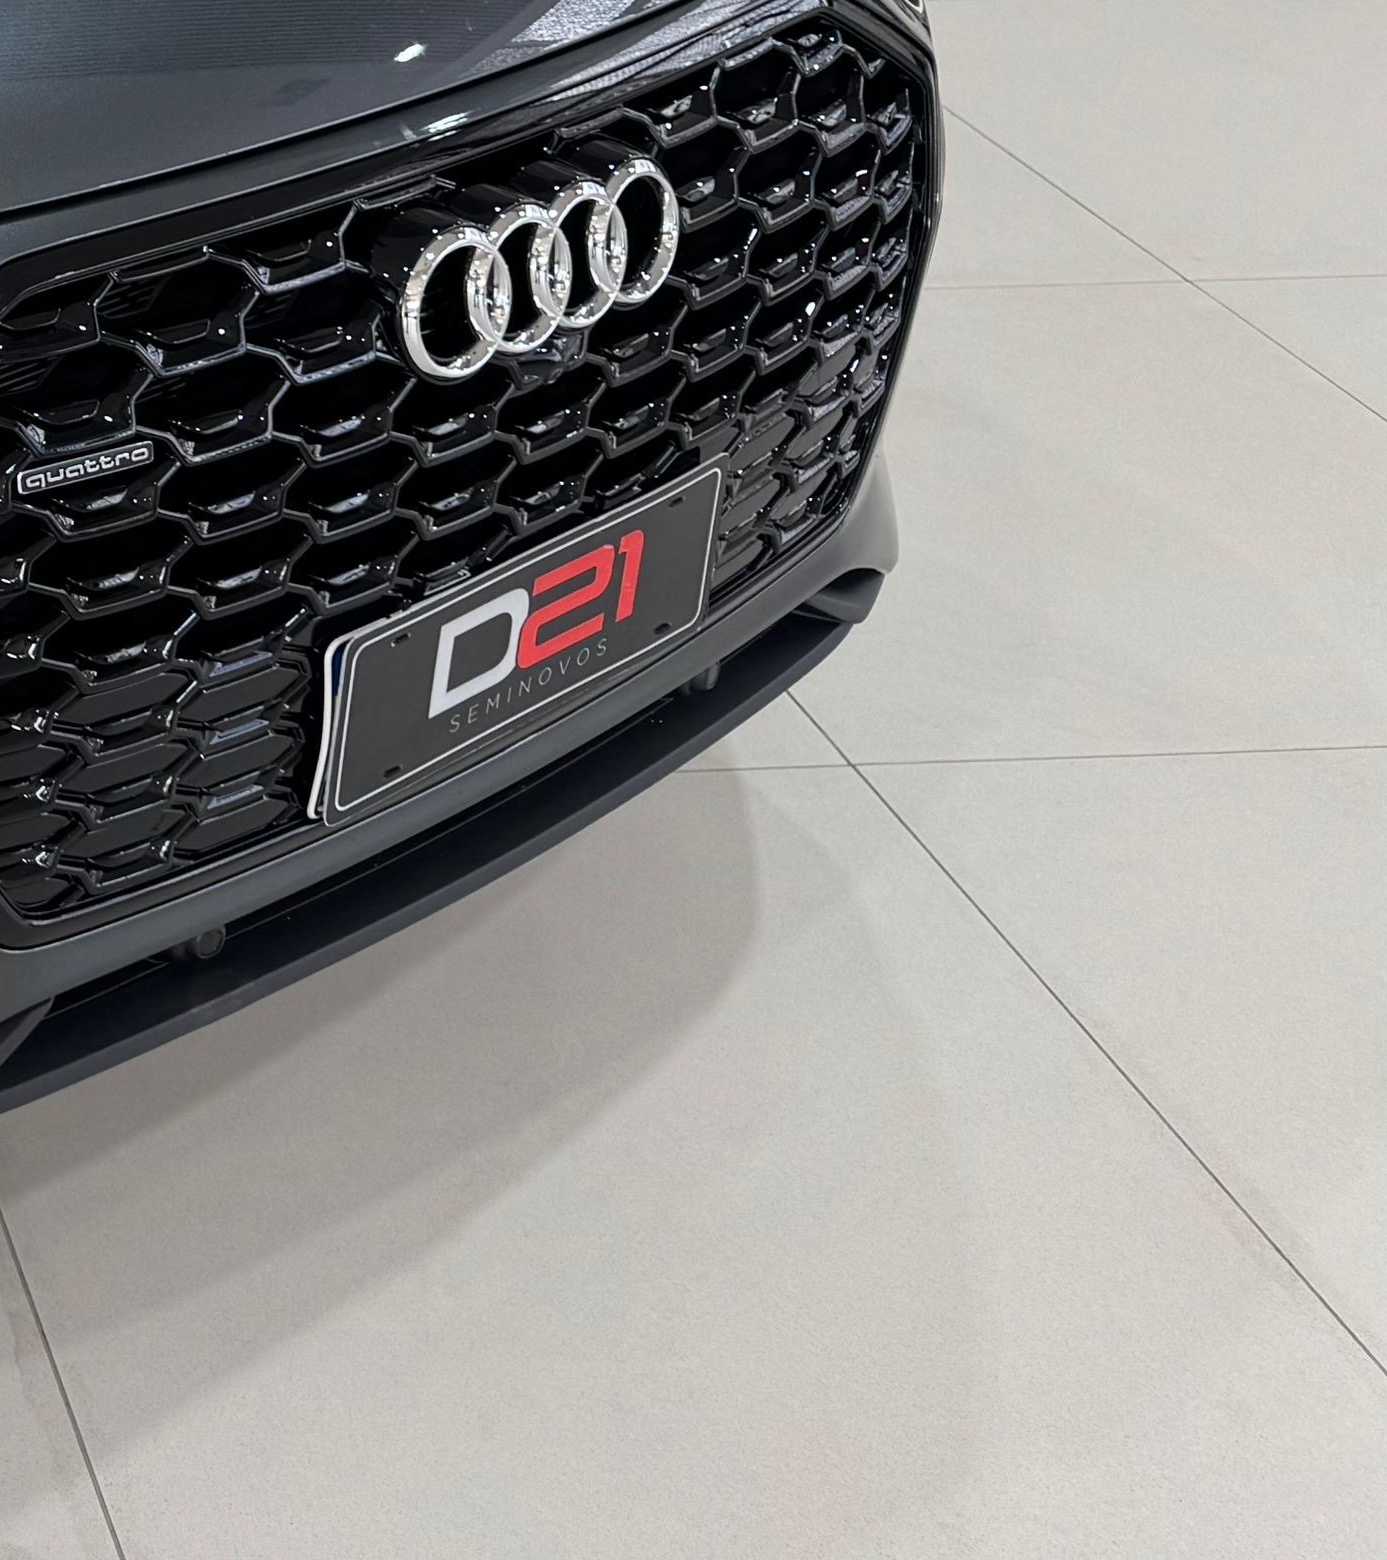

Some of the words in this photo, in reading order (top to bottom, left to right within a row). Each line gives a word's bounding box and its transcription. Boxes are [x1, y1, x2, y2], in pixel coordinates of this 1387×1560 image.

[25, 447, 149, 488] quattro
[428, 528, 645, 720] D21
[448, 638, 609, 734] SEMINOVOS
